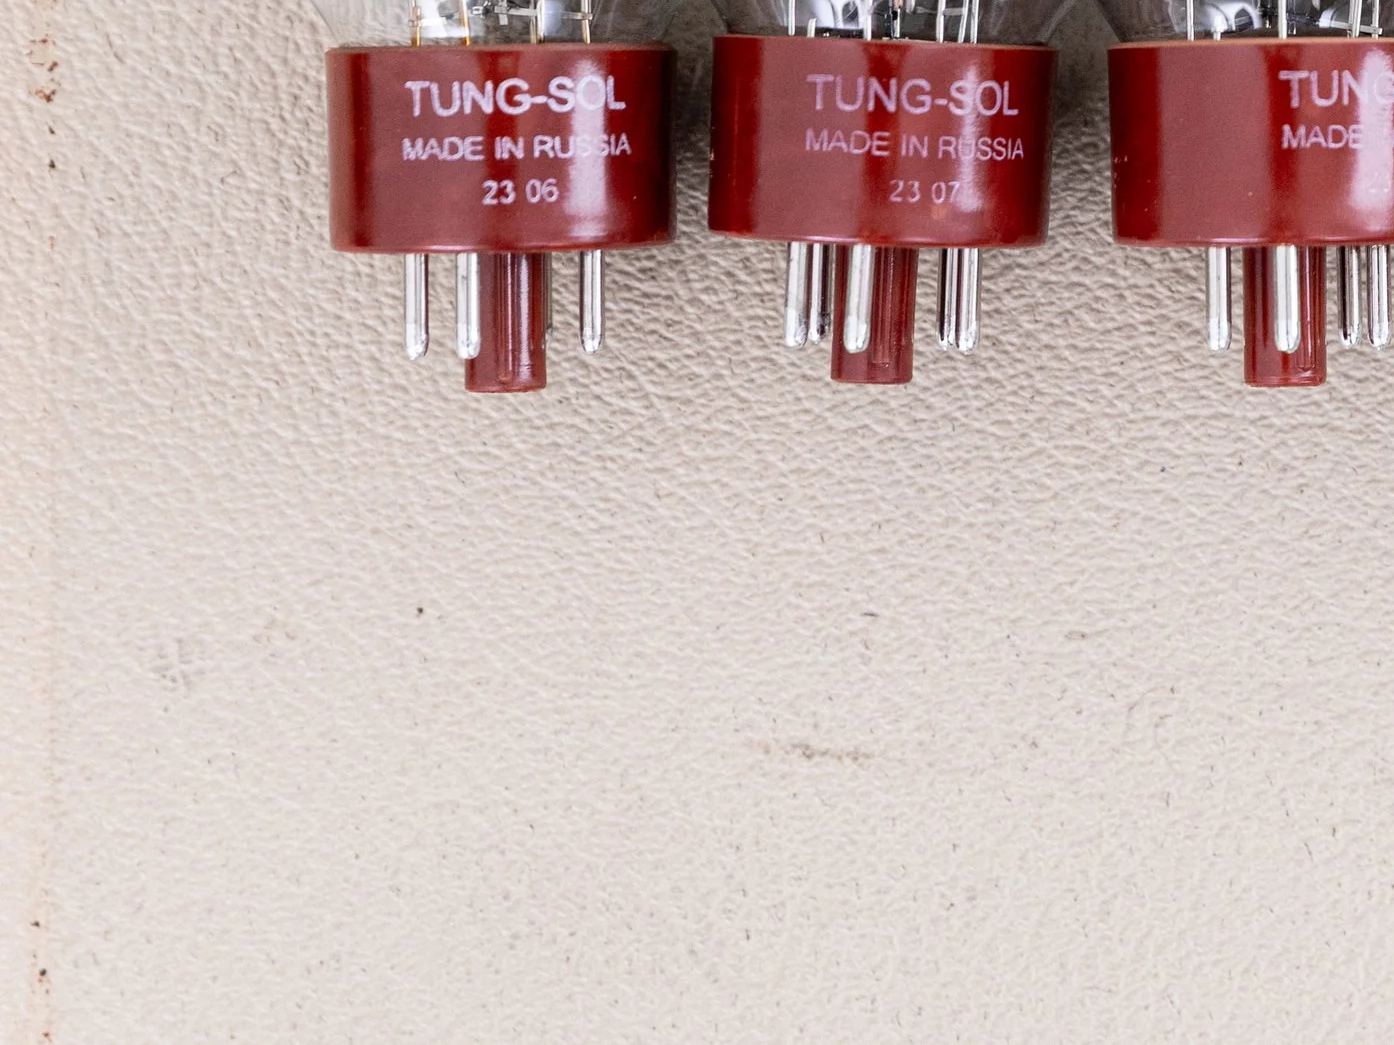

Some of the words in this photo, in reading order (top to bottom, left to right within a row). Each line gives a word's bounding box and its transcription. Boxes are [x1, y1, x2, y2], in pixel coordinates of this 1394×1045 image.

[404, 75, 627, 116] TUNG-SOL
[806, 74, 1019, 117] TUNG-SOL
[402, 136, 485, 161] MADE
[494, 135, 525, 159] IN
[533, 132, 632, 159] RUSSIA
[805, 127, 890, 156] MADE
[901, 133, 929, 159] IN
[938, 135, 1024, 161] RUSSIA
[1281, 124, 1364, 150] MADE
[482, 180, 516, 205] 23
[525, 178, 560, 203] 06
[889, 180, 921, 203] 23
[930, 181, 961, 204] 07
